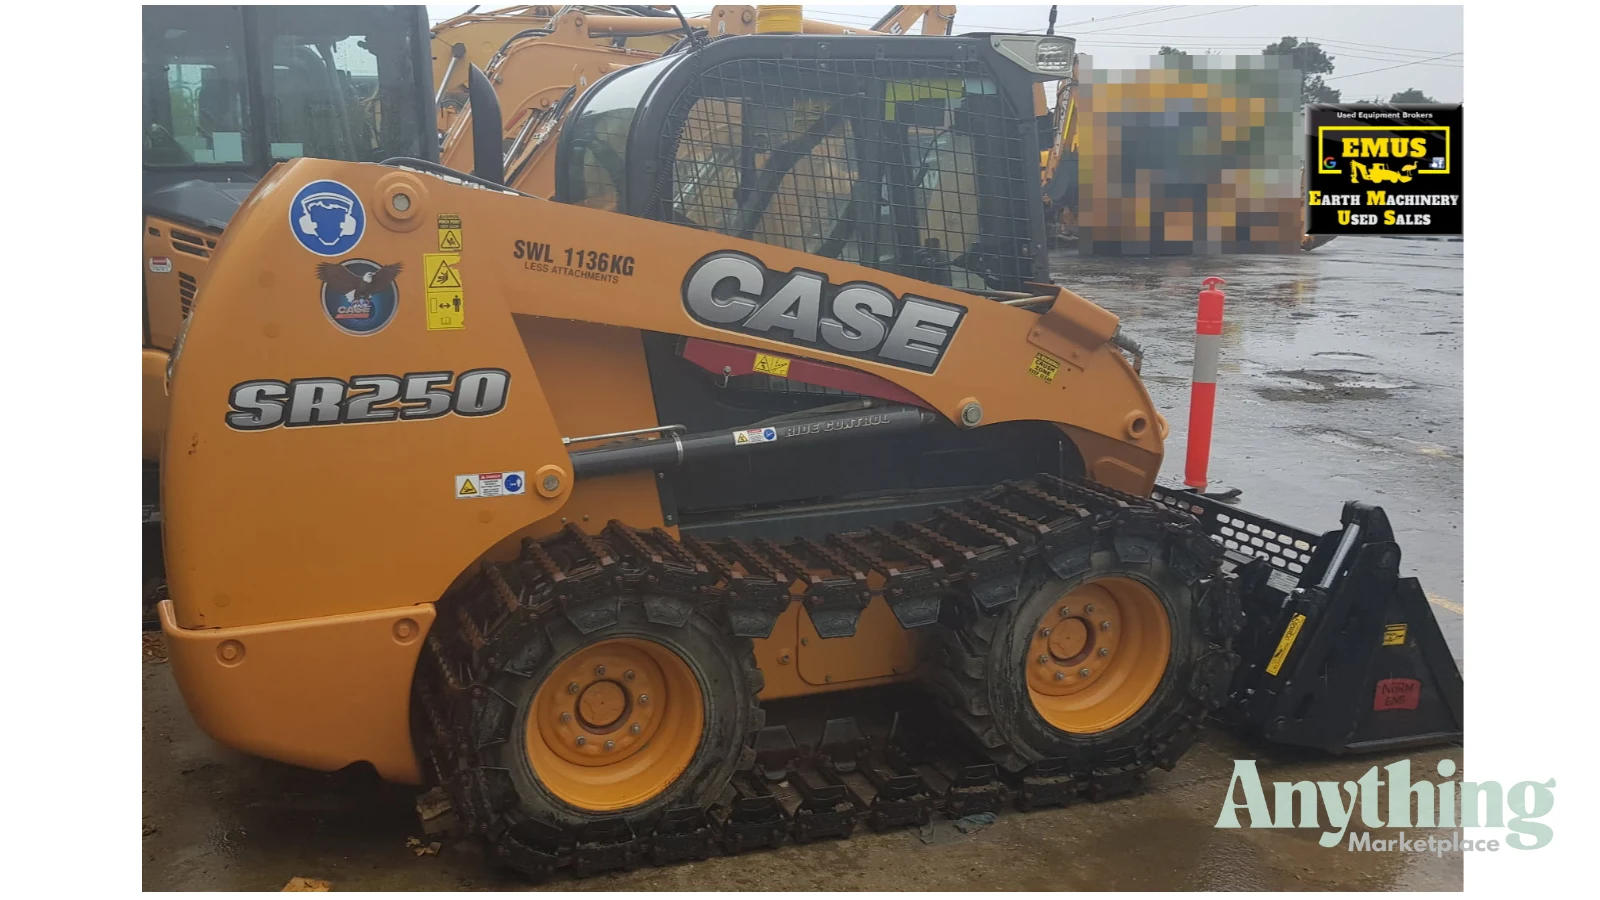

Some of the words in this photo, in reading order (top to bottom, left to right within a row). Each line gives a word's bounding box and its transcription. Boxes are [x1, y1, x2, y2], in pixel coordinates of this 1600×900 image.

[513, 239, 554, 263] SWL
[564, 247, 635, 276] 1136KG
[524, 261, 549, 273] LESS
[551, 265, 619, 284] ATTACHMENTS
[337, 305, 371, 314] CASE
[685, 253, 964, 369] CASE
[226, 368, 510, 431] SR250
[785, 423, 820, 438] RIDE
[823, 414, 891, 432] CONTROL
